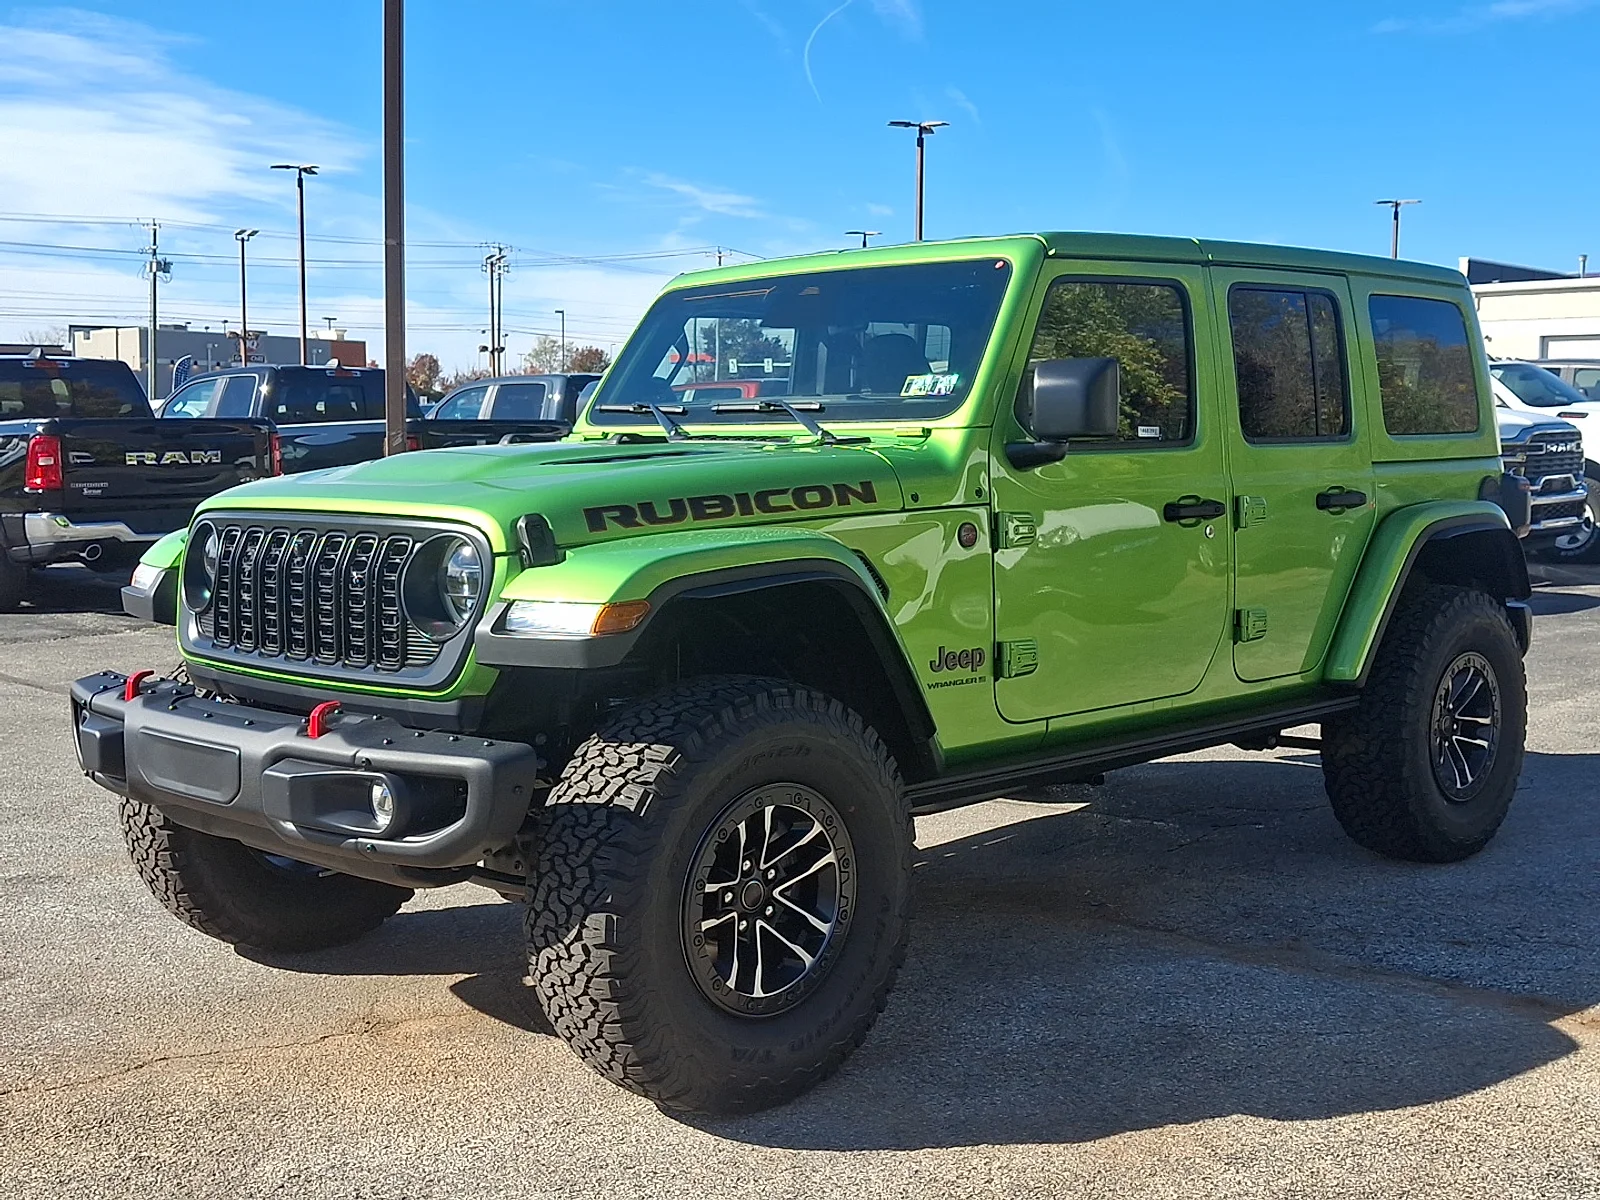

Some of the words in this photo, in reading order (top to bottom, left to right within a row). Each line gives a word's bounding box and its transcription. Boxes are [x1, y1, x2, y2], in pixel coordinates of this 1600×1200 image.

[125, 450, 222, 466] RAM
[582, 480, 878, 533] RUBICON
[929, 645, 986, 673] Jeep
[926, 678, 977, 690] WRANGLER
